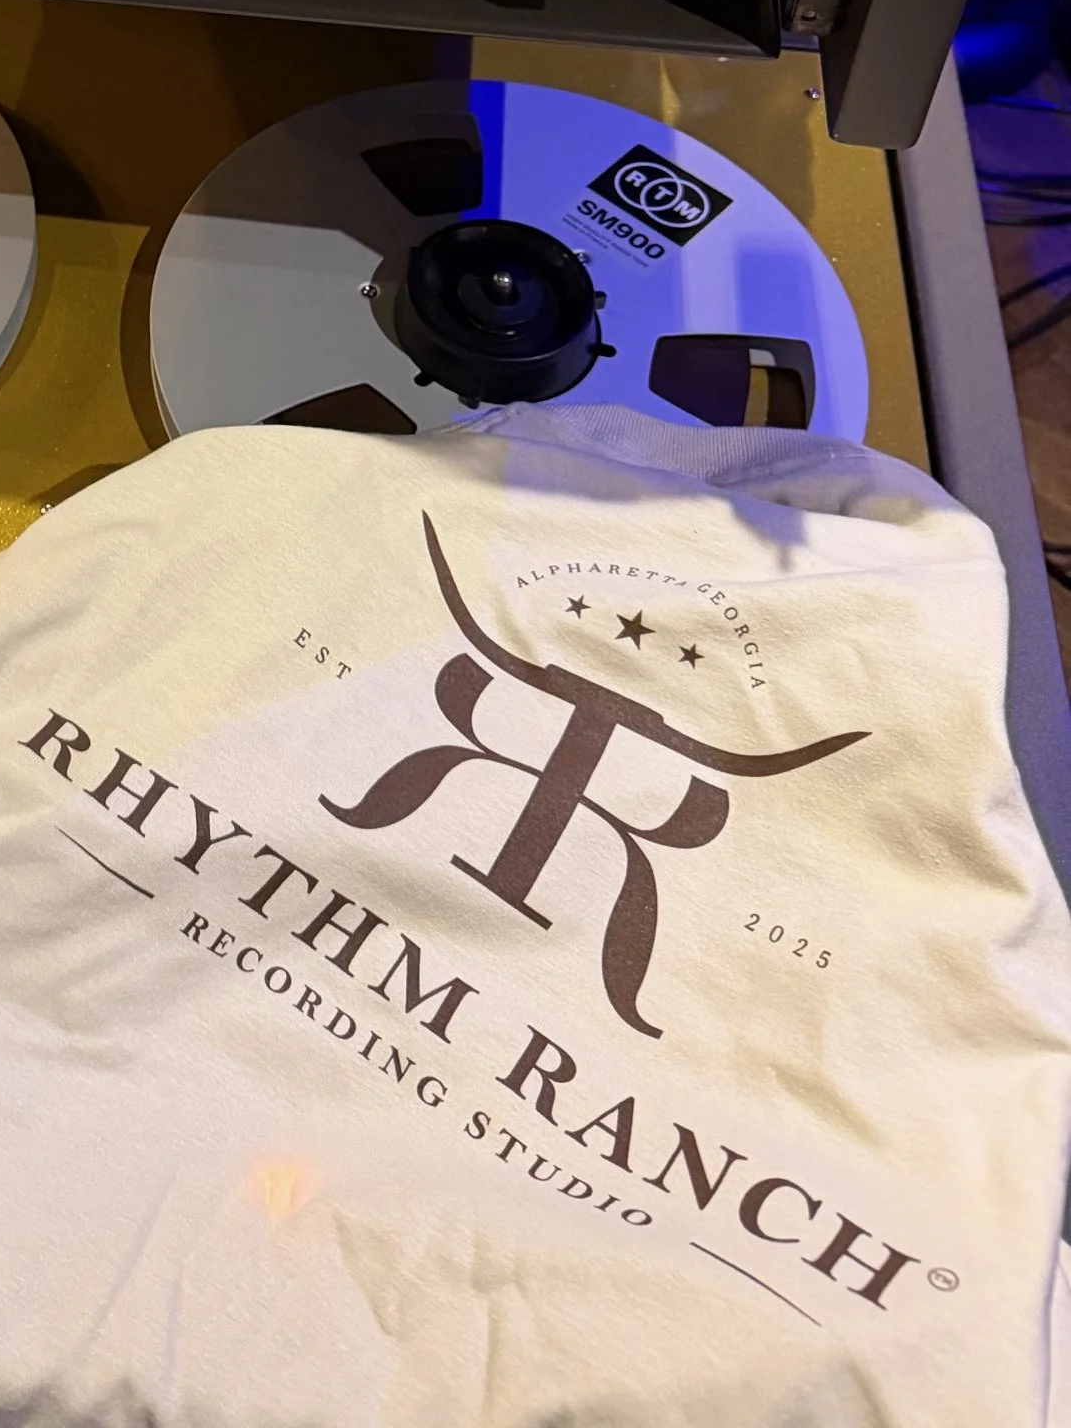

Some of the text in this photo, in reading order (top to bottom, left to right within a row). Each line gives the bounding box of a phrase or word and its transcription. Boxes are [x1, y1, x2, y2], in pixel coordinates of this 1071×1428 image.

[625, 171, 701, 220] RTM
[577, 200, 665, 259] SM900
[293, 626, 353, 680] EST
[516, 562, 766, 689] ALPHARETTA GEORGIA
[744, 913, 832, 970] 2025
[18, 708, 480, 1044] RHYTHM
[494, 1024, 921, 1312] RANCH
[180, 911, 654, 1227] RECORDING STUDIO
